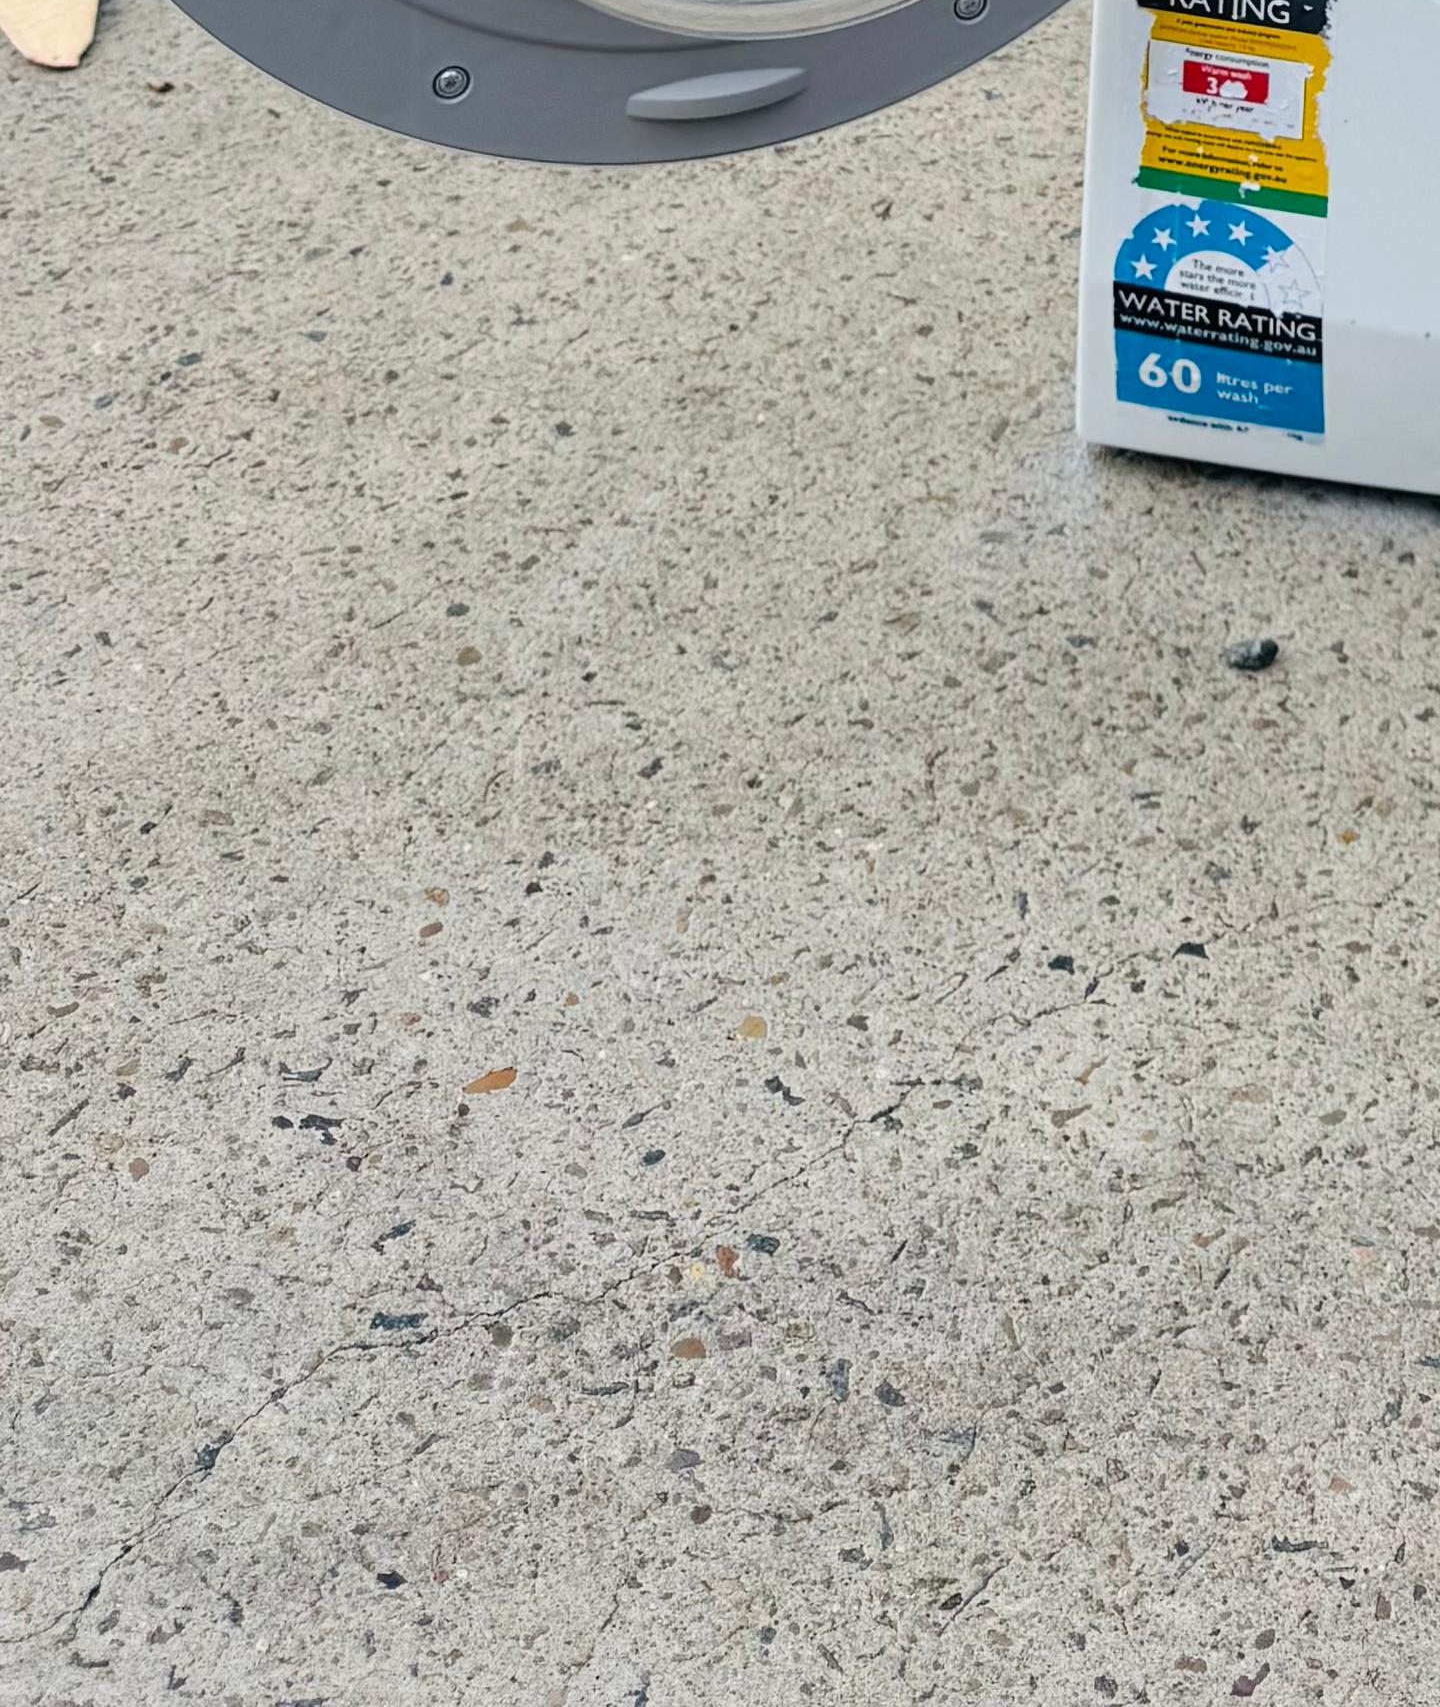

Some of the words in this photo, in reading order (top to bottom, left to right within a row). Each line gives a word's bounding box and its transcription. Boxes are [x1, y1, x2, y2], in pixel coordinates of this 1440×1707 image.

[1201, 64, 1229, 78] Warm
[1230, 69, 1252, 81] wash
[1215, 54, 1270, 69] consumption
[1162, 145, 1176, 154] For
[1178, 149, 1201, 159] more
[1252, 160, 1275, 171] refer
[1158, 155, 1288, 184] www.energyrating.gov.au
[1193, 258, 1212, 271] The
[1215, 265, 1245, 277] more
[1179, 269, 1205, 281] stars
[1206, 273, 1225, 285] the
[1227, 277, 1257, 289] more
[1180, 281, 1212, 293] water
[1118, 289, 1211, 325] WATER
[1218, 308, 1316, 342] RATING
[1119, 313, 1317, 357] www.waterrating.gov.au
[1138, 352, 1202, 395] 60
[1216, 371, 1259, 391] litres
[1263, 380, 1293, 395] per
[1216, 388, 1259, 404] wash
